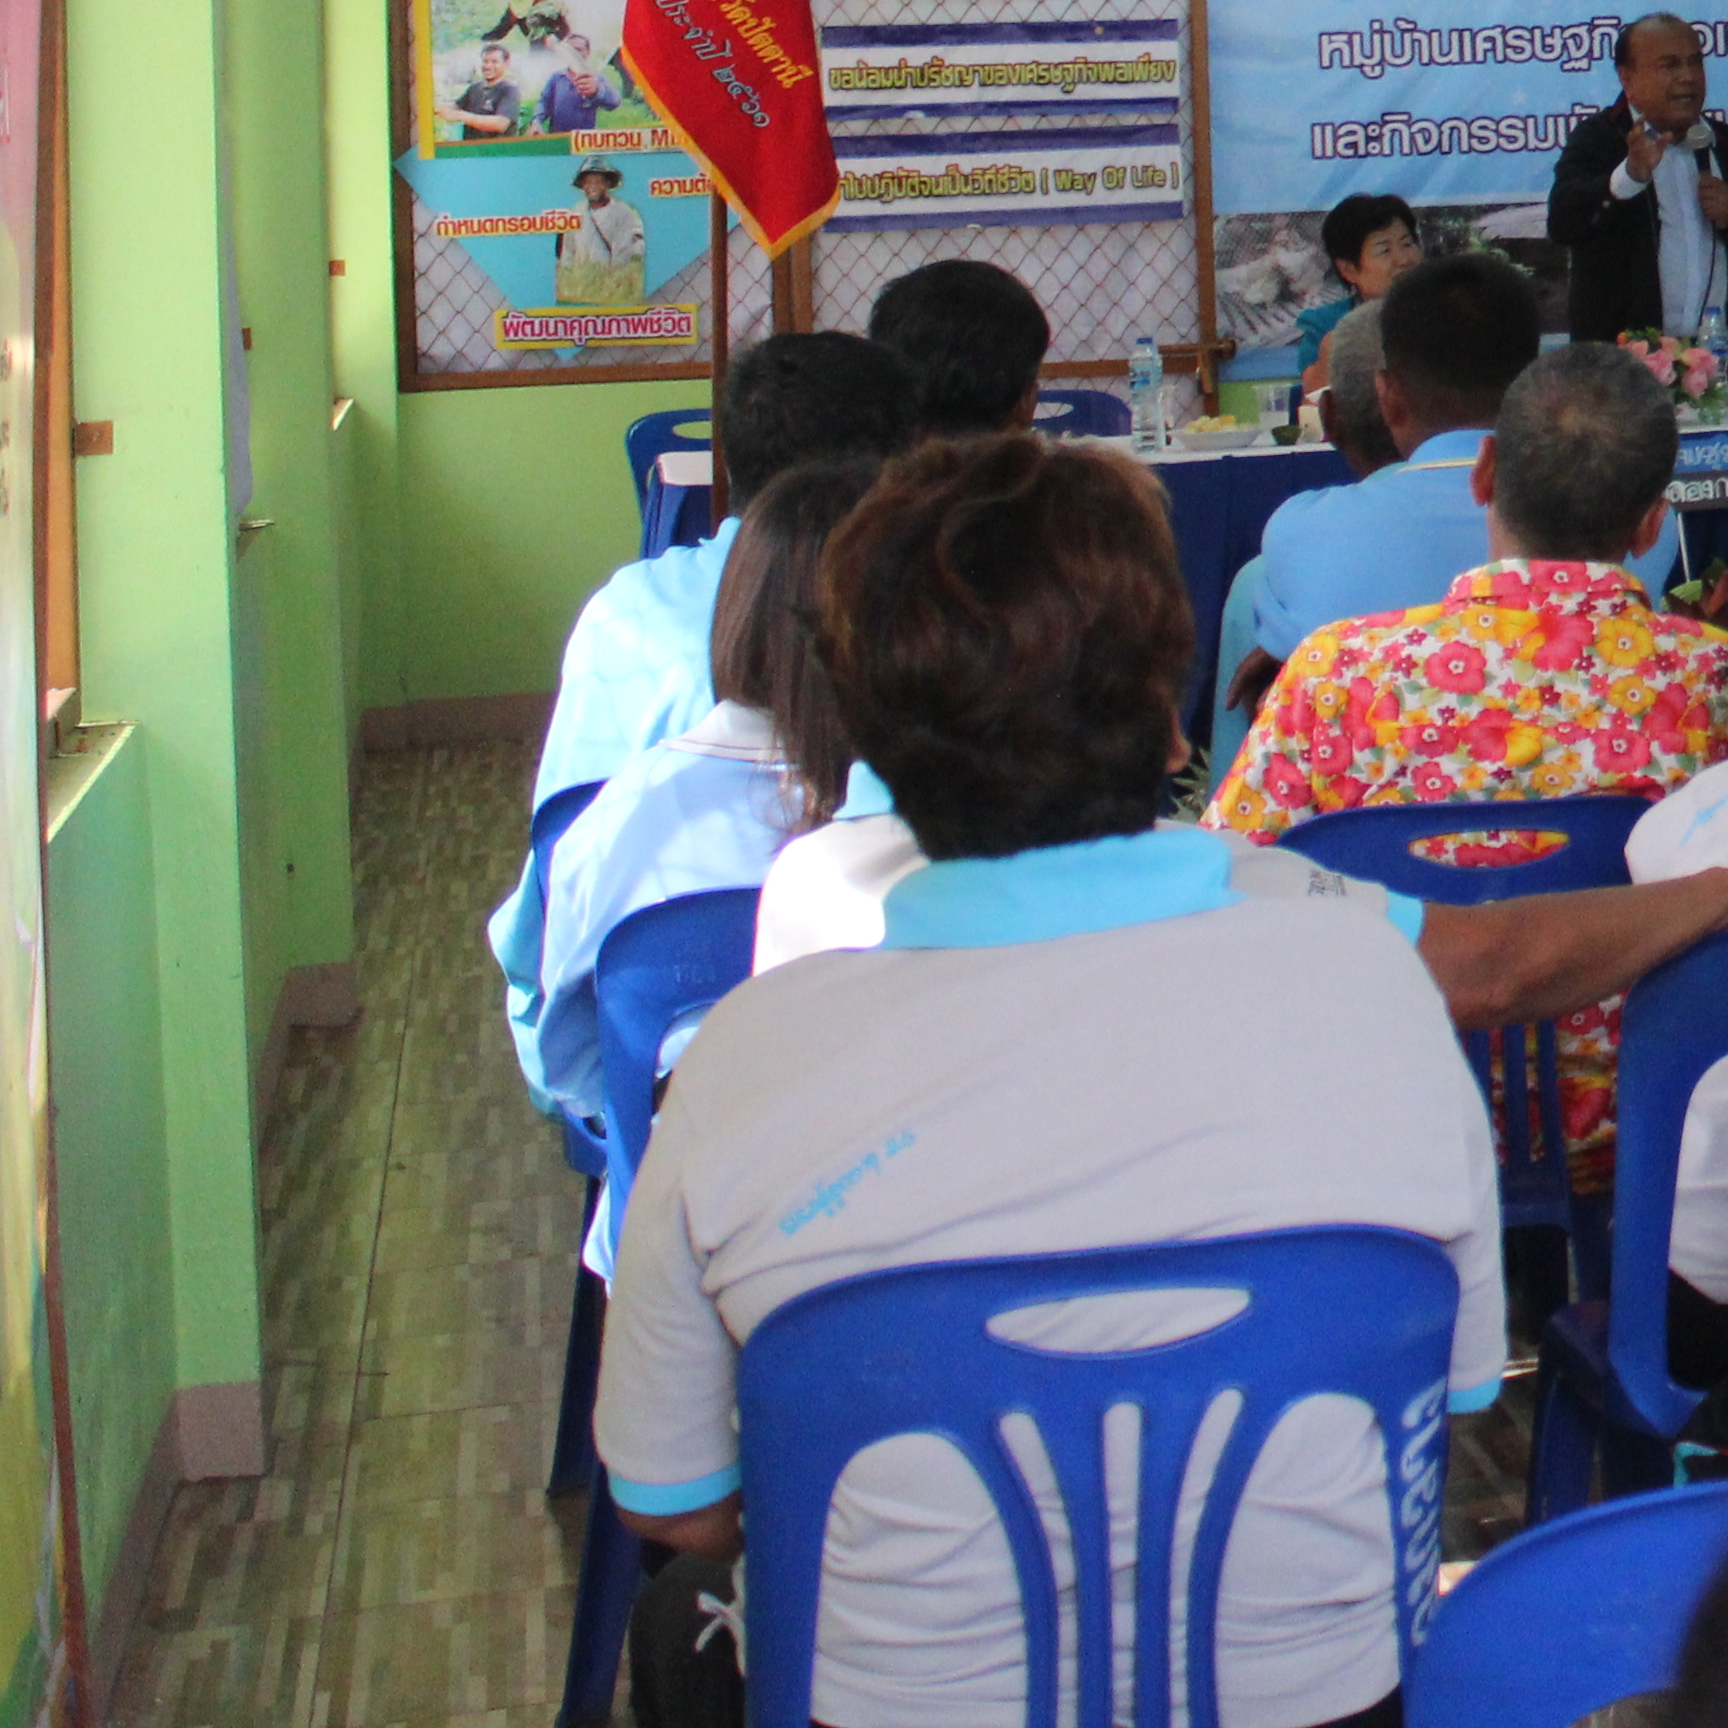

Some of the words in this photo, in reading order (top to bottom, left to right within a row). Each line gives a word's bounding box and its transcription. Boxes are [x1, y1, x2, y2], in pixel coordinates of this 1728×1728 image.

[829, 53, 1176, 93] ขอน้อมนำปรัชญาของเศรษฐกิจพอเพียง
[1054, 171, 1096, 195] Way
[1103, 168, 1126, 189] Of
[1132, 165, 1167, 189] Life
[436, 211, 583, 238] กำหนดกรอบชีวิต
[502, 310, 694, 344] พัฒนาคุณภาพชีวิต
